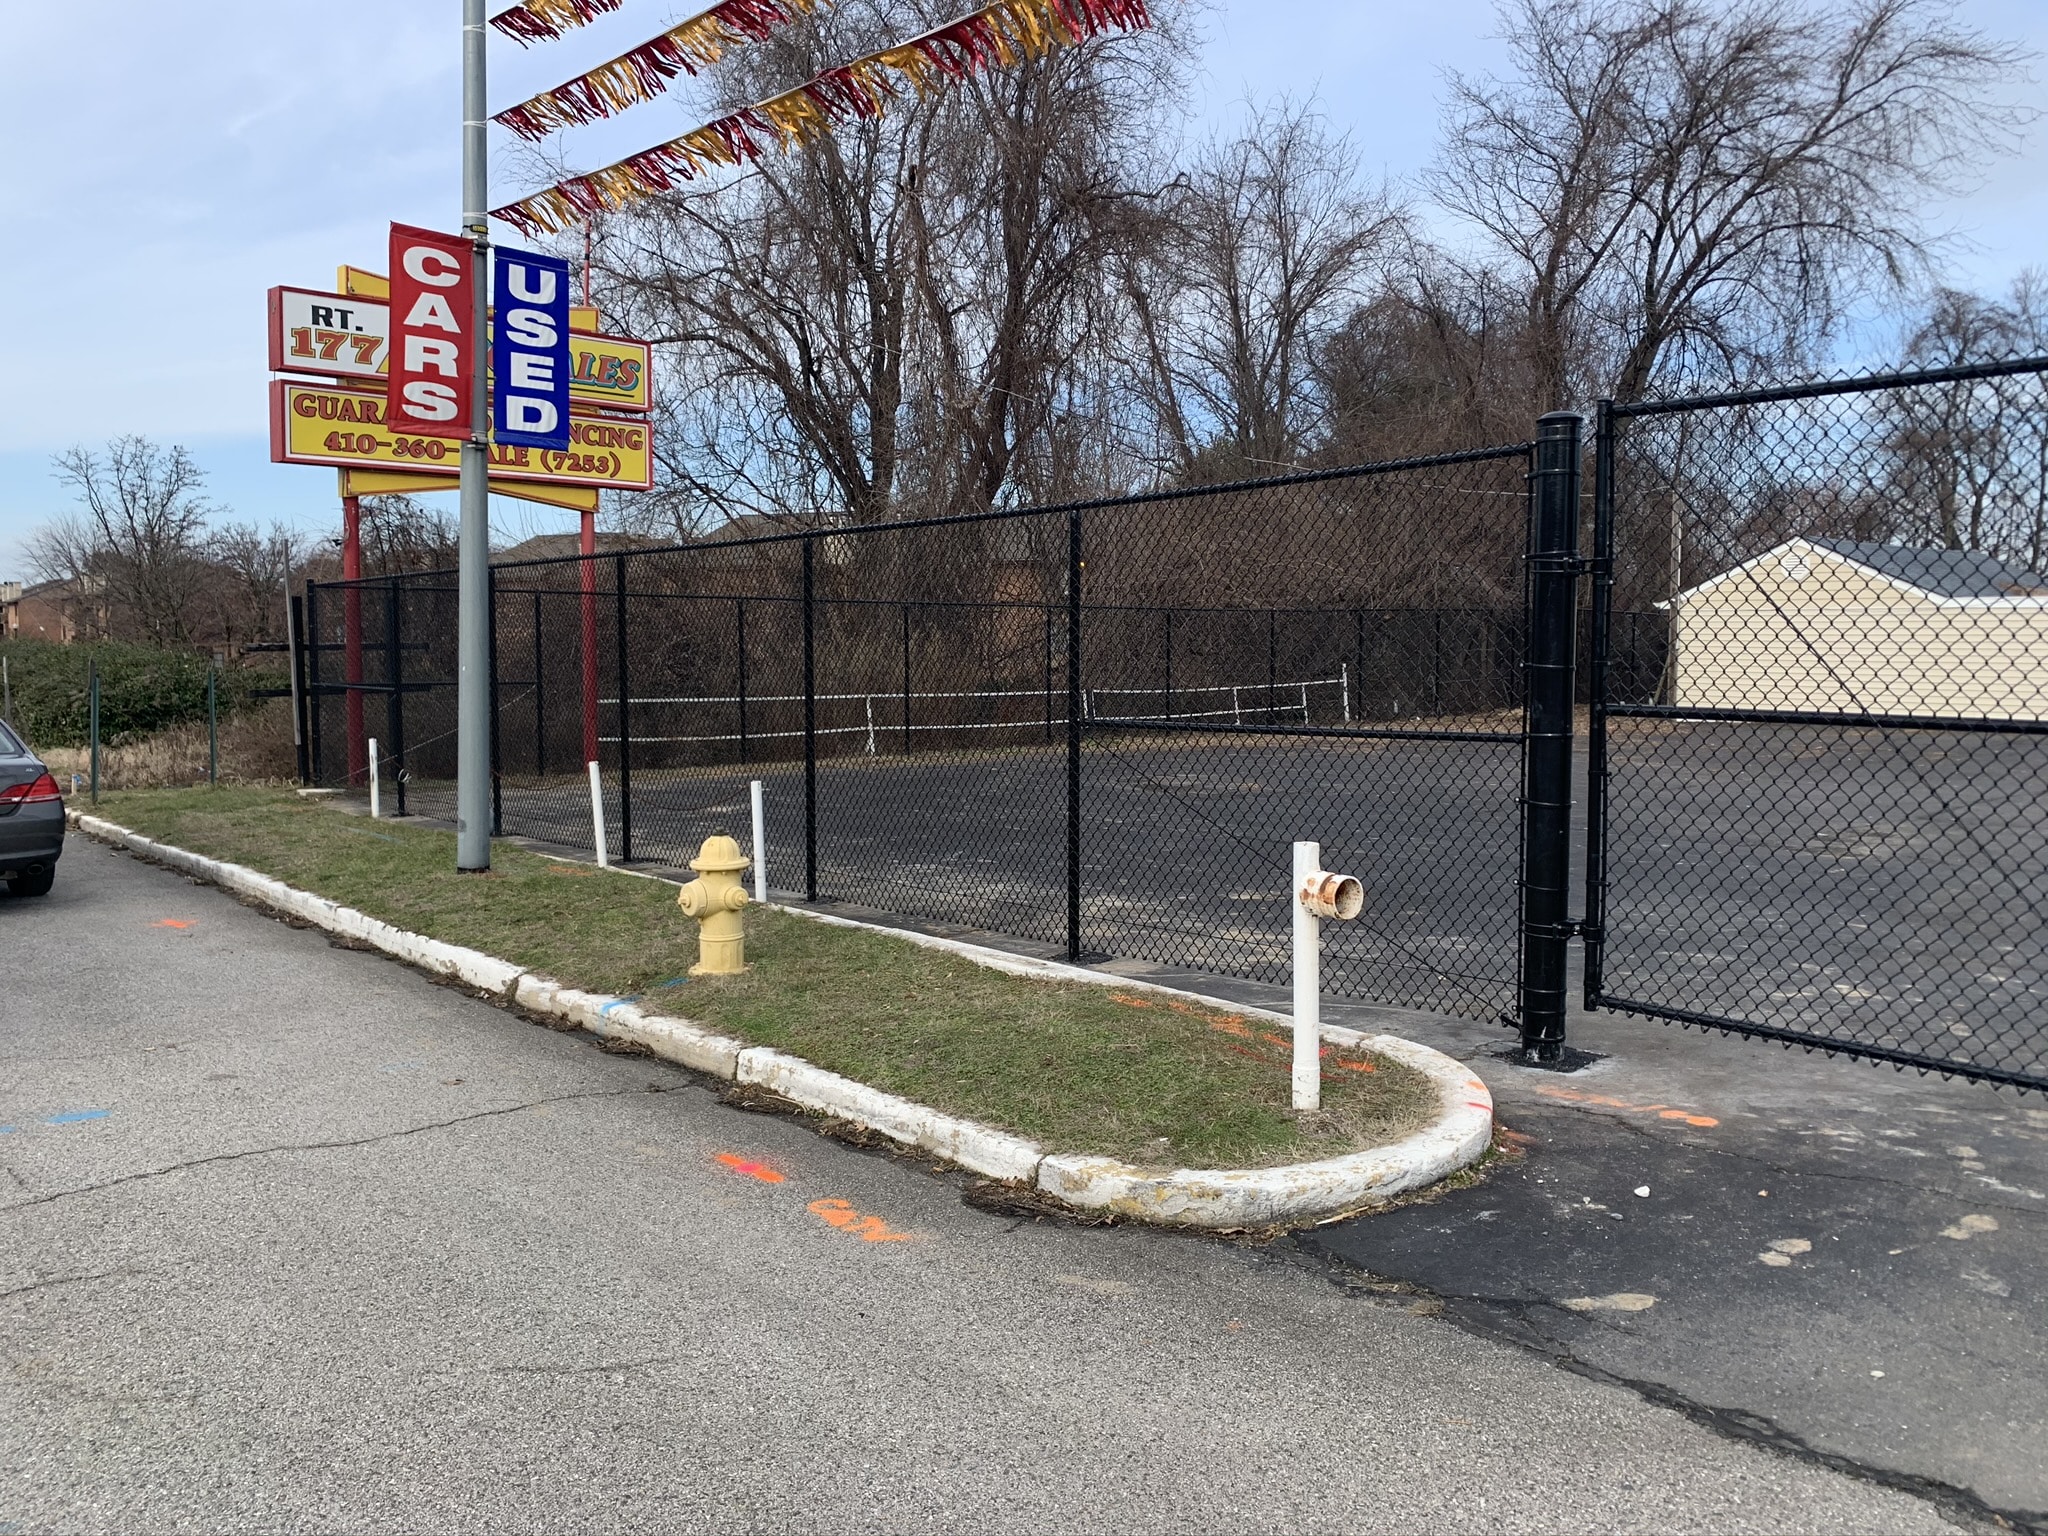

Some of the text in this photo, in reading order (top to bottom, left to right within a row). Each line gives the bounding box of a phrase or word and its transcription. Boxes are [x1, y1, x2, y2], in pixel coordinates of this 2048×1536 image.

[311, 304, 364, 332] RT.
[402, 246, 461, 421] CARS
[290, 326, 384, 365] 177
[506, 263, 558, 433] USED
[540, 448, 621, 478] (7253)
